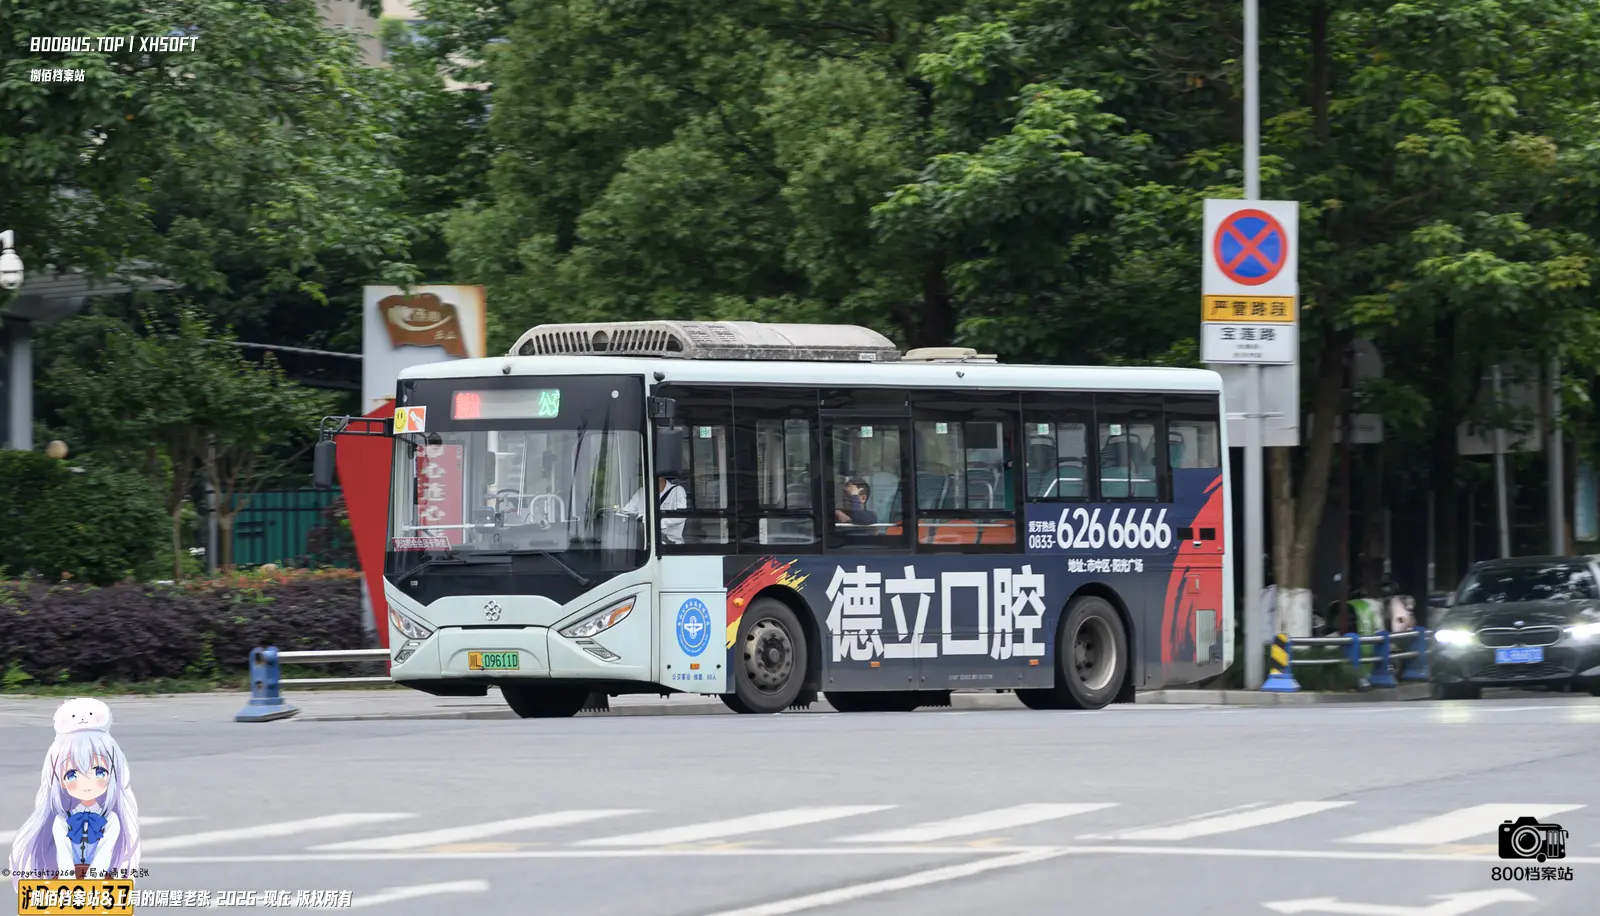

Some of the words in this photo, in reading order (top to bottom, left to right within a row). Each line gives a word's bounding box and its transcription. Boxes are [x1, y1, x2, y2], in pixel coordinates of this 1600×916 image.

[1220, 327, 1276, 341] 宝莲路
[1028, 520, 1056, 533] 爱牙热线
[825, 564, 1047, 662] 德立口腔
